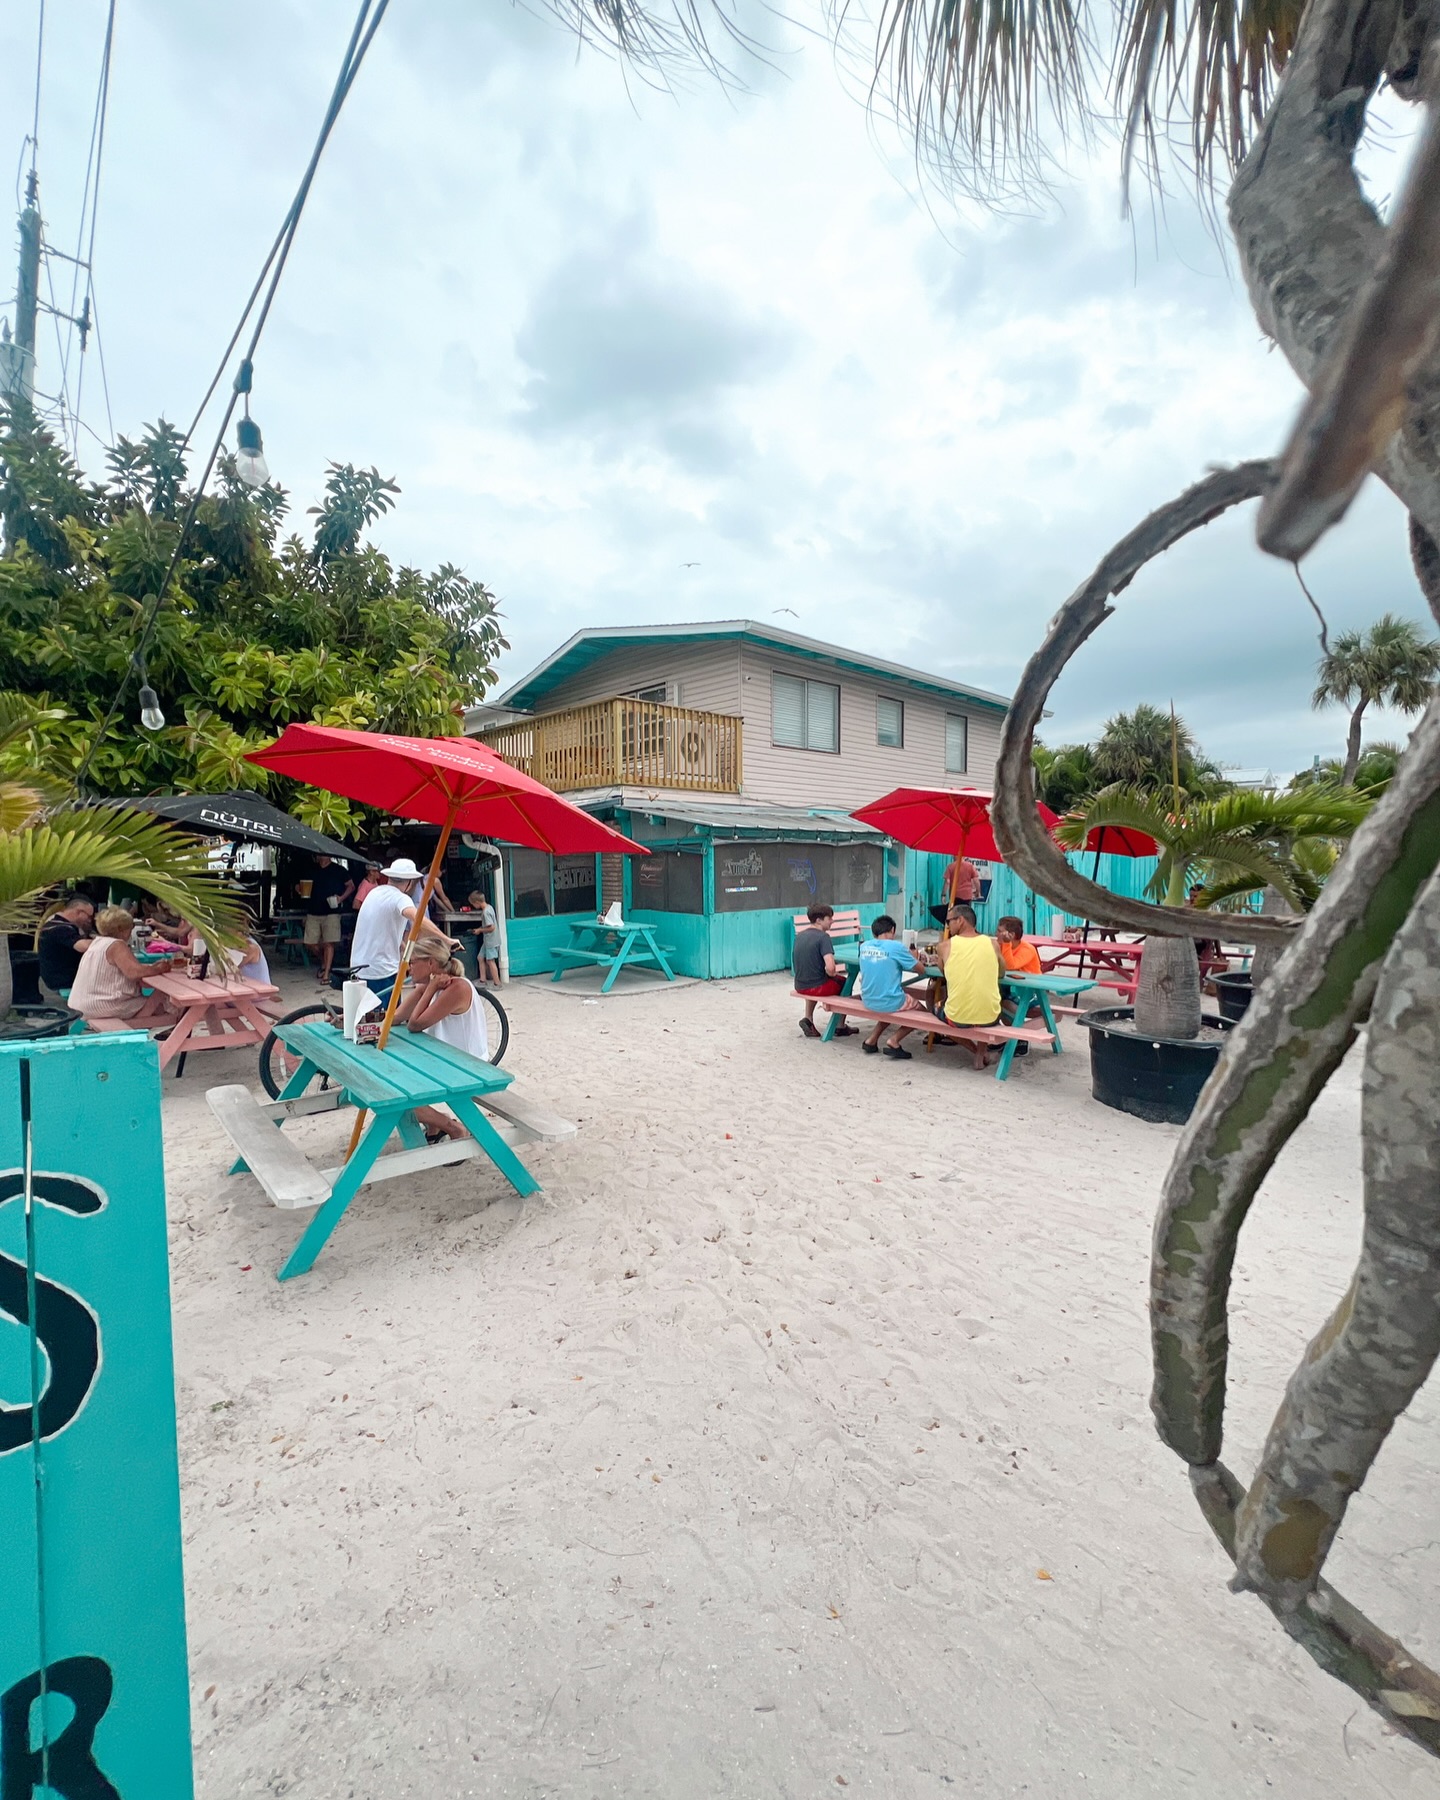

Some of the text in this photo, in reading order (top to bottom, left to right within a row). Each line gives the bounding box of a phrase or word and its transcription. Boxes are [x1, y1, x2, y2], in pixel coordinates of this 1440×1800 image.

[378, 738, 495, 773] More Sundays
[426, 747, 496, 769] Mondays
[221, 852, 246, 864] Glf
